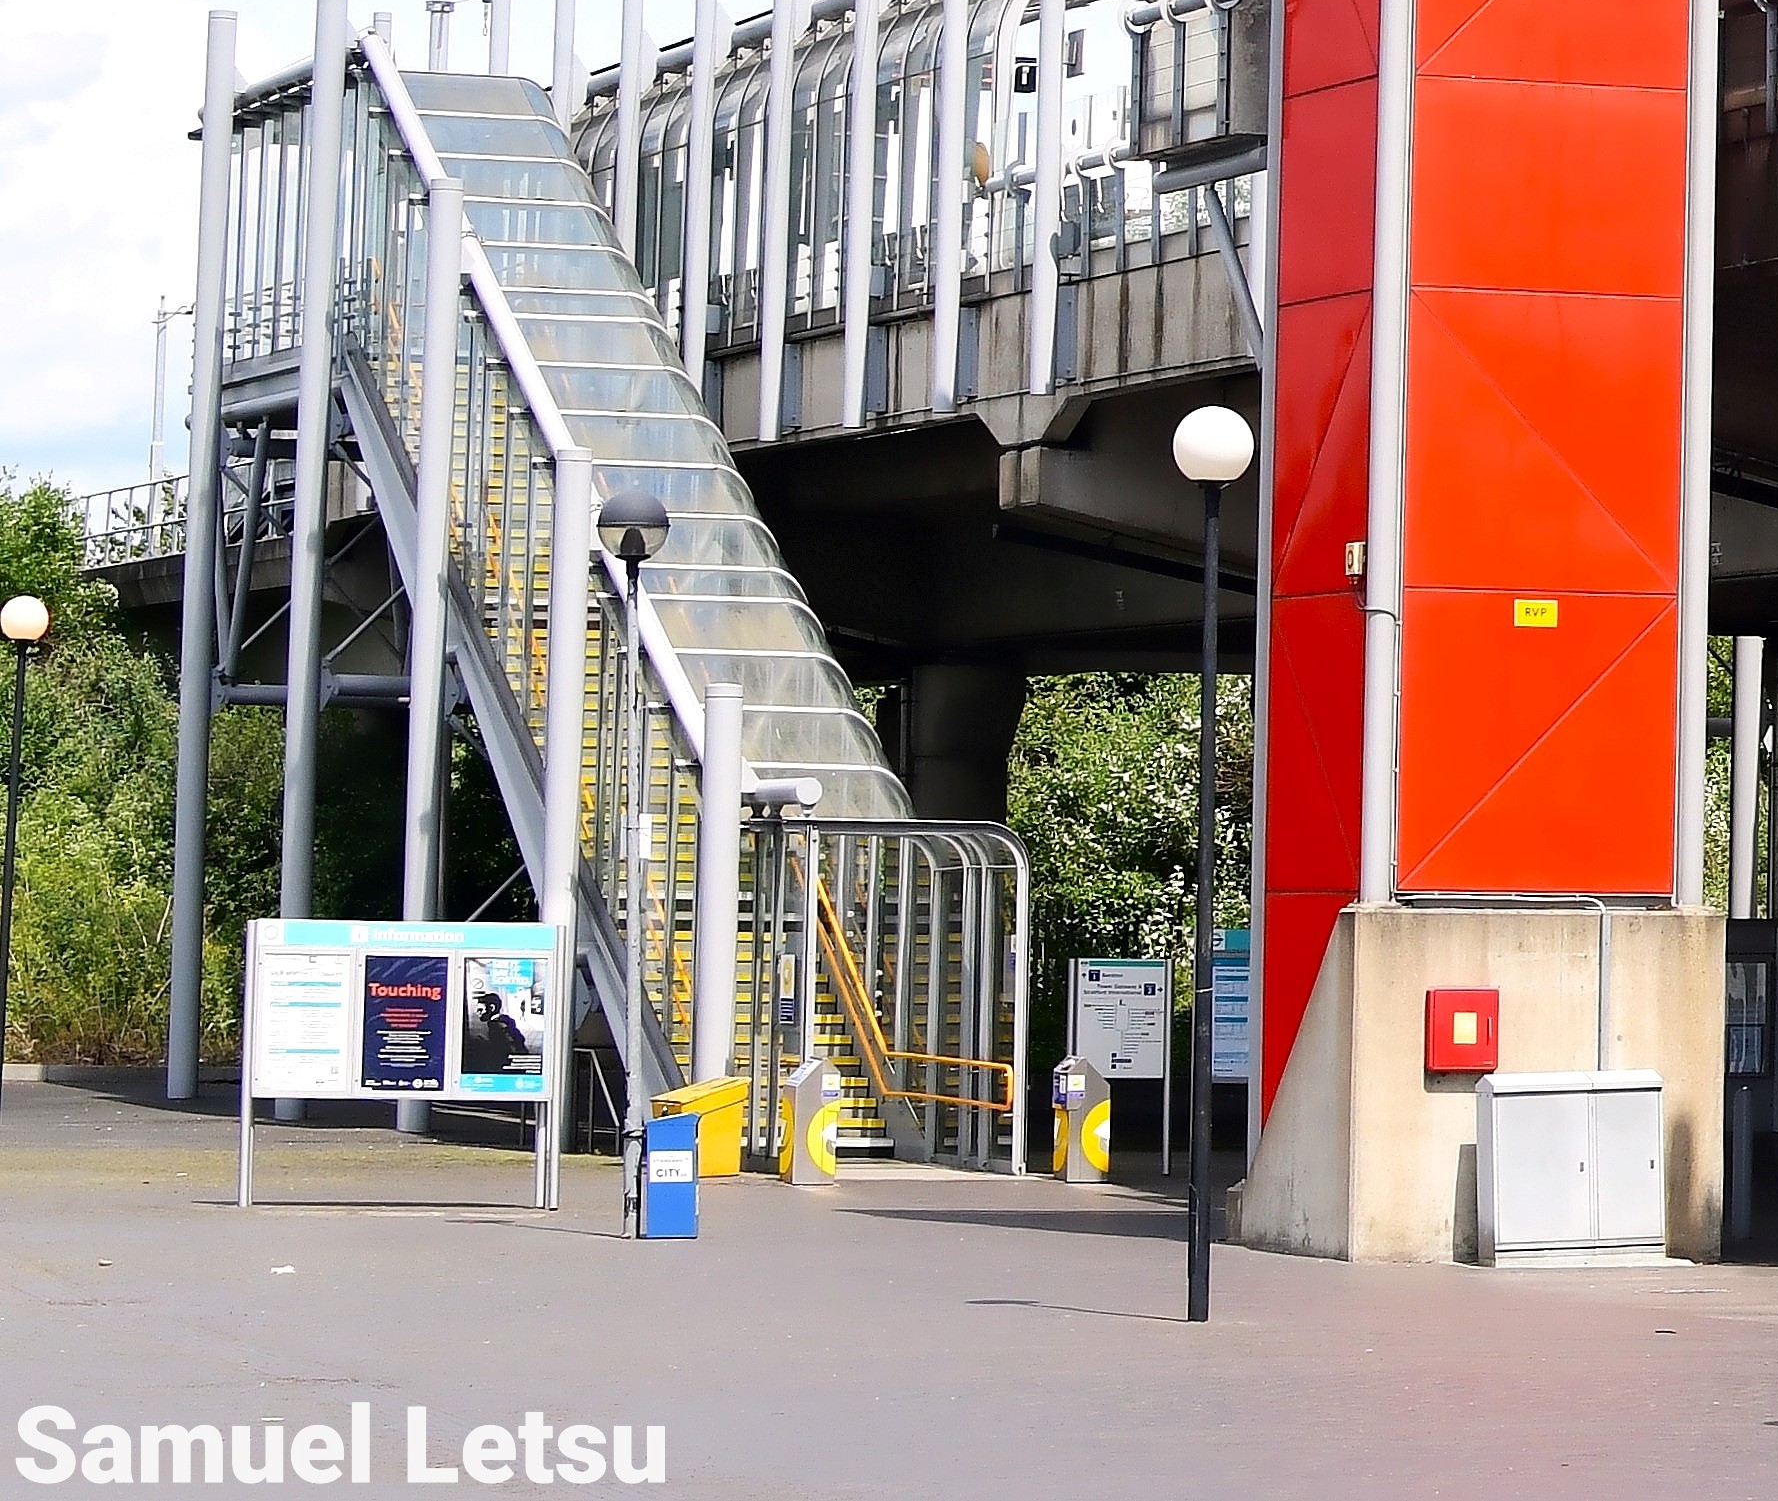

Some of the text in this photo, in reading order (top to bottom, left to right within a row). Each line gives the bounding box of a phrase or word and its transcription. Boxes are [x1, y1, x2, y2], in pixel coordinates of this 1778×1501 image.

[1524, 607, 1548, 618] RVP
[374, 927, 466, 943] Information
[367, 983, 442, 1001] Touching
[656, 1168, 681, 1178] CITY
